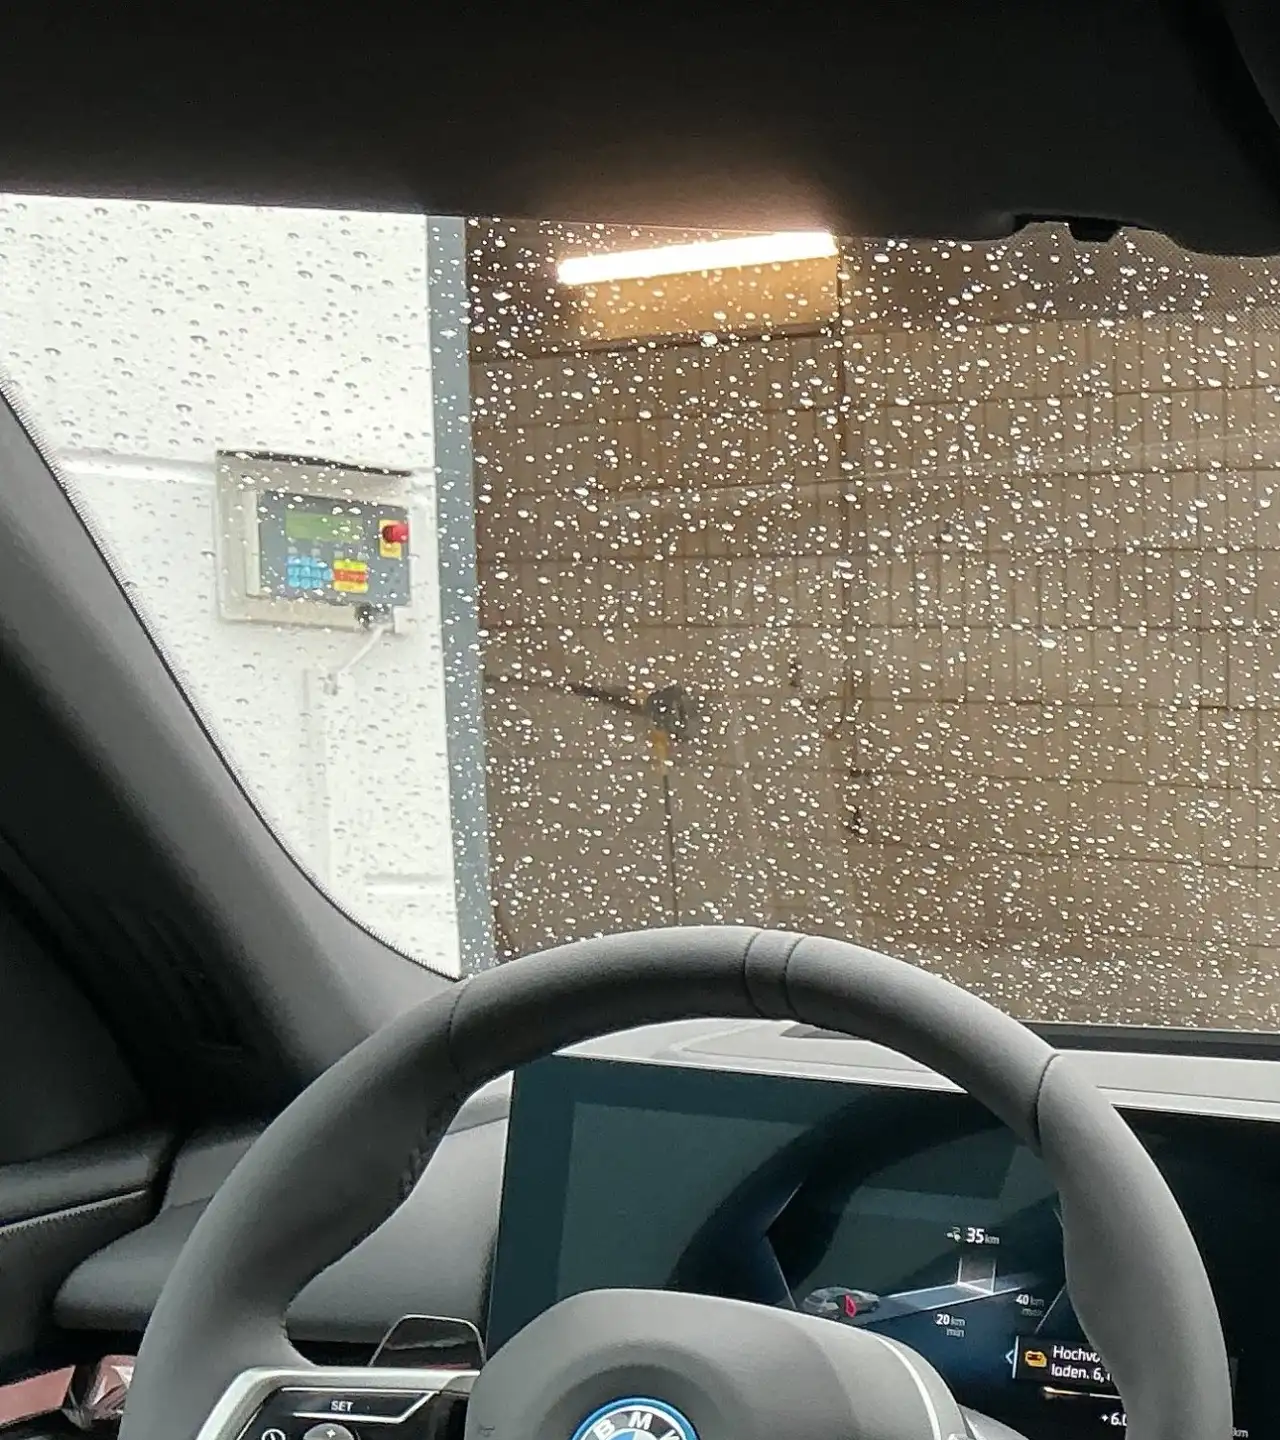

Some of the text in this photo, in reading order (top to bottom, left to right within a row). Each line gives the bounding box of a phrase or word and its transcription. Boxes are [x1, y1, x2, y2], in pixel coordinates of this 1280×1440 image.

[966, 1226, 985, 1244] 35
[1015, 1293, 1030, 1306] 40
[935, 1313, 966, 1327] 20 km
[946, 1327, 965, 1338] min
[1051, 1363, 1090, 1380] laden.
[330, 1399, 354, 1412] SET
